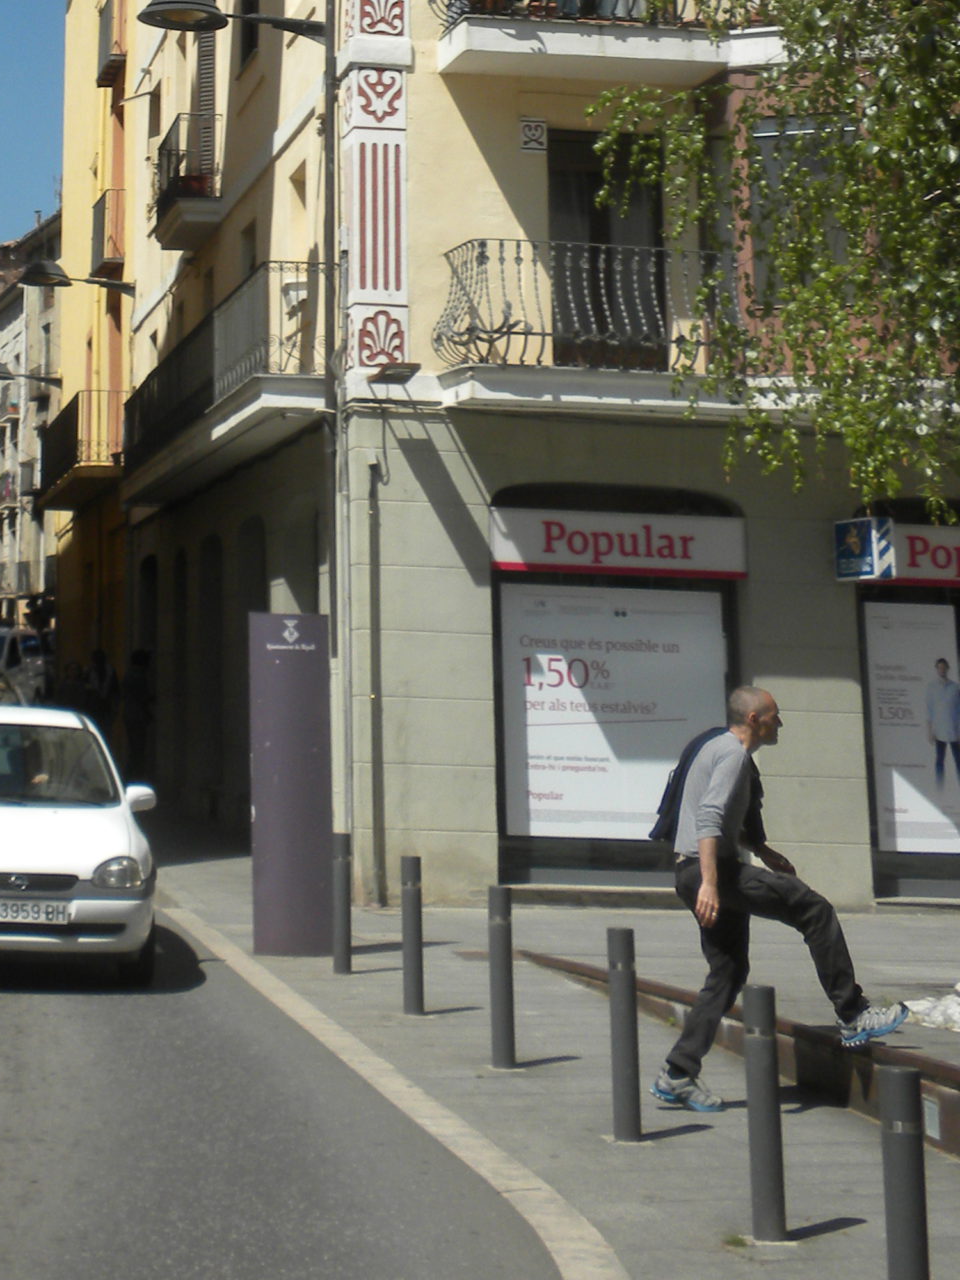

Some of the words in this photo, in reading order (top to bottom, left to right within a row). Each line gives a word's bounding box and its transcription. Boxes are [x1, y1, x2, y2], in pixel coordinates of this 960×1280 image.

[542, 520, 695, 564] Popular
[519, 634, 558, 650] Creus
[559, 639, 586, 652] que
[605, 639, 659, 654] possible
[662, 642, 681, 654] un
[524, 699, 546, 712] per
[548, 698, 568, 712] als
[569, 700, 598, 713] teus
[600, 700, 657, 715] estalvis?
